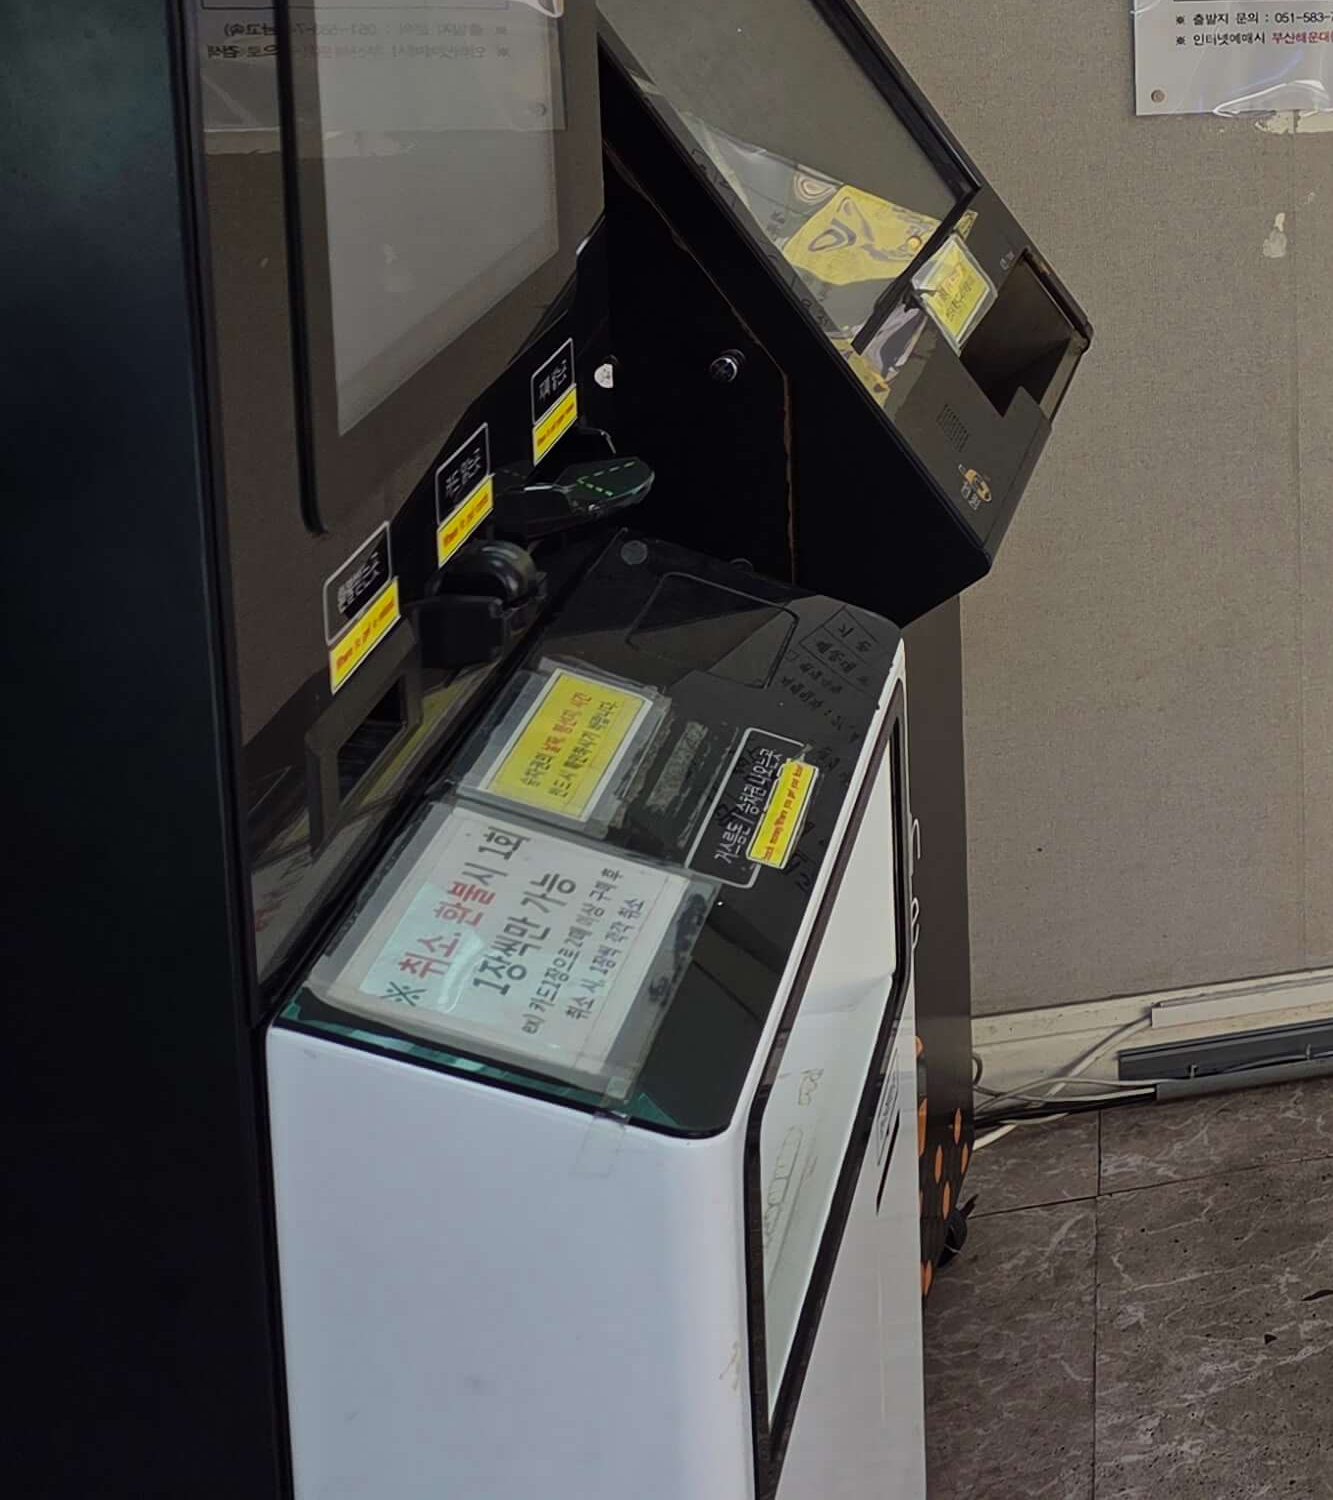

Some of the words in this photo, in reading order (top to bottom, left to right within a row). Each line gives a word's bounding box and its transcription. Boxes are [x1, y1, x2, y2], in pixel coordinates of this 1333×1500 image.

[1193, 12, 1229, 25] 출발지
[1236, 11, 1259, 25] 문의
[1193, 31, 1266, 46] 인터넷예매시
[433, 862, 508, 930] 환불시
[478, 826, 532, 861] 1회
[473, 916, 552, 997] 1장씩만
[521, 872, 577, 914] 가능
